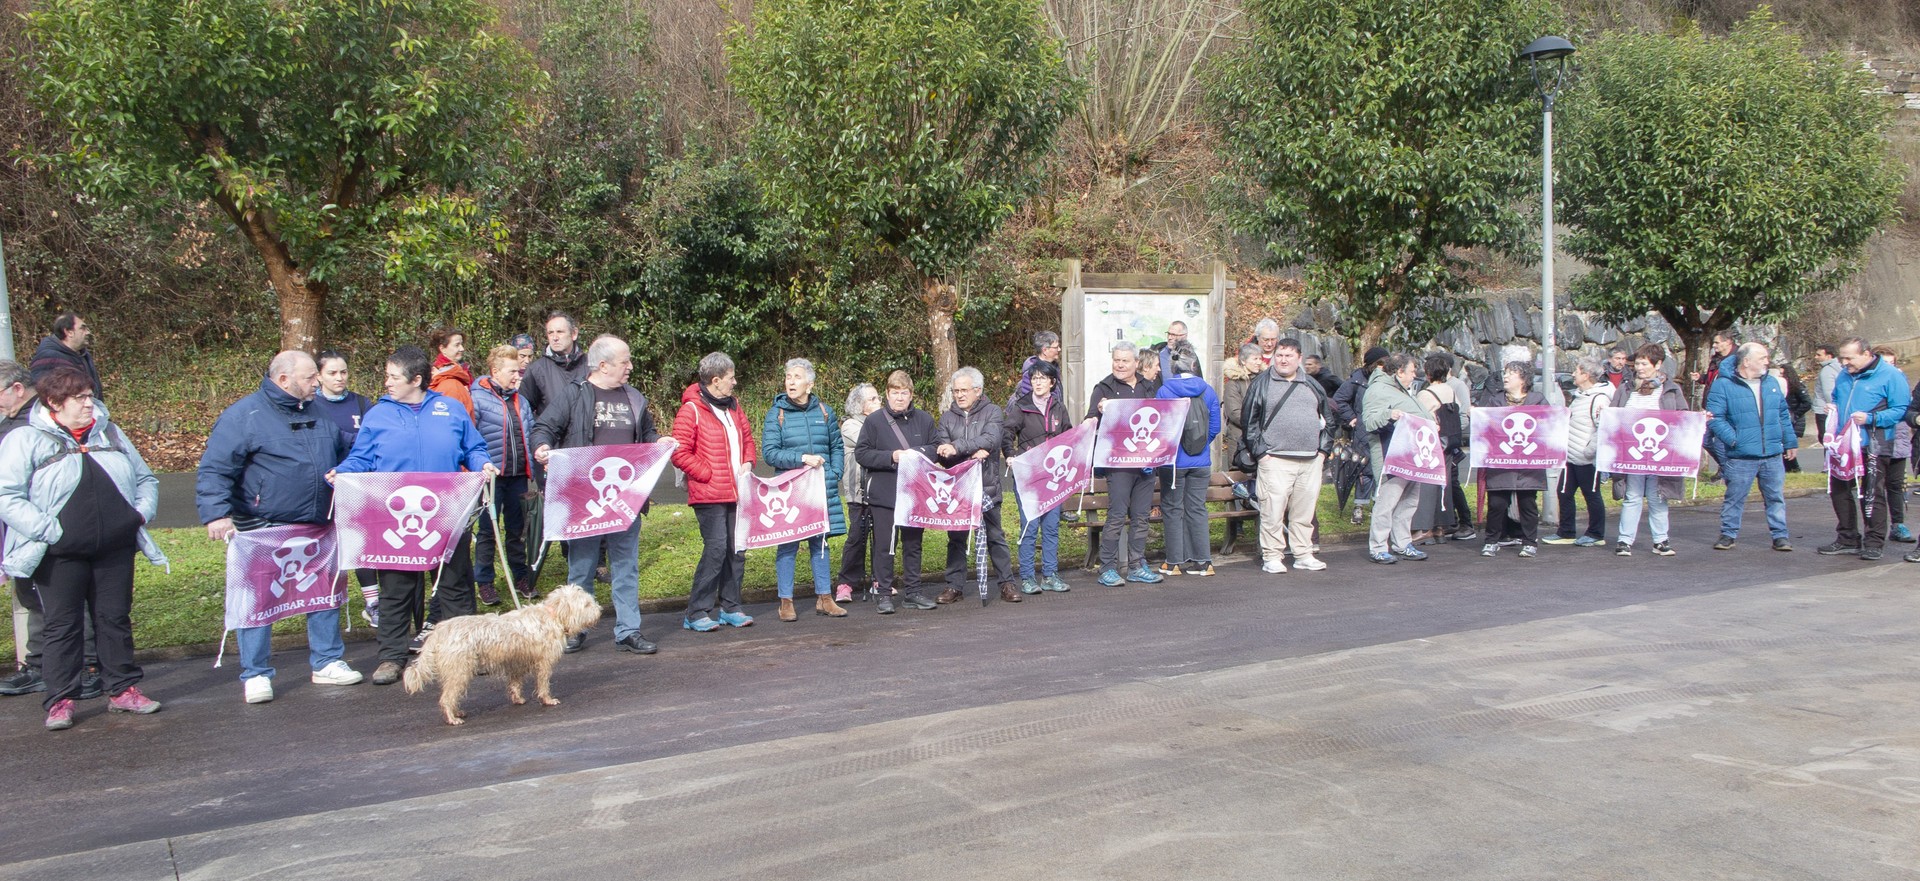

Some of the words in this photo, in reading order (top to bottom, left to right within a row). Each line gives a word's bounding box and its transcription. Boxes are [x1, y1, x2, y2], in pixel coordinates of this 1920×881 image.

[1612, 463, 1657, 472] #ZALDIBAR
[566, 518, 623, 534] #ZALDIBAR
[908, 515, 952, 526] #ZALDIBAR
[748, 528, 795, 544] #ZALDIBAR
[360, 555, 427, 565] #ZALDIBAR
[250, 599, 305, 621] #ZALDIBAR
[308, 591, 344, 606] ARGIT
